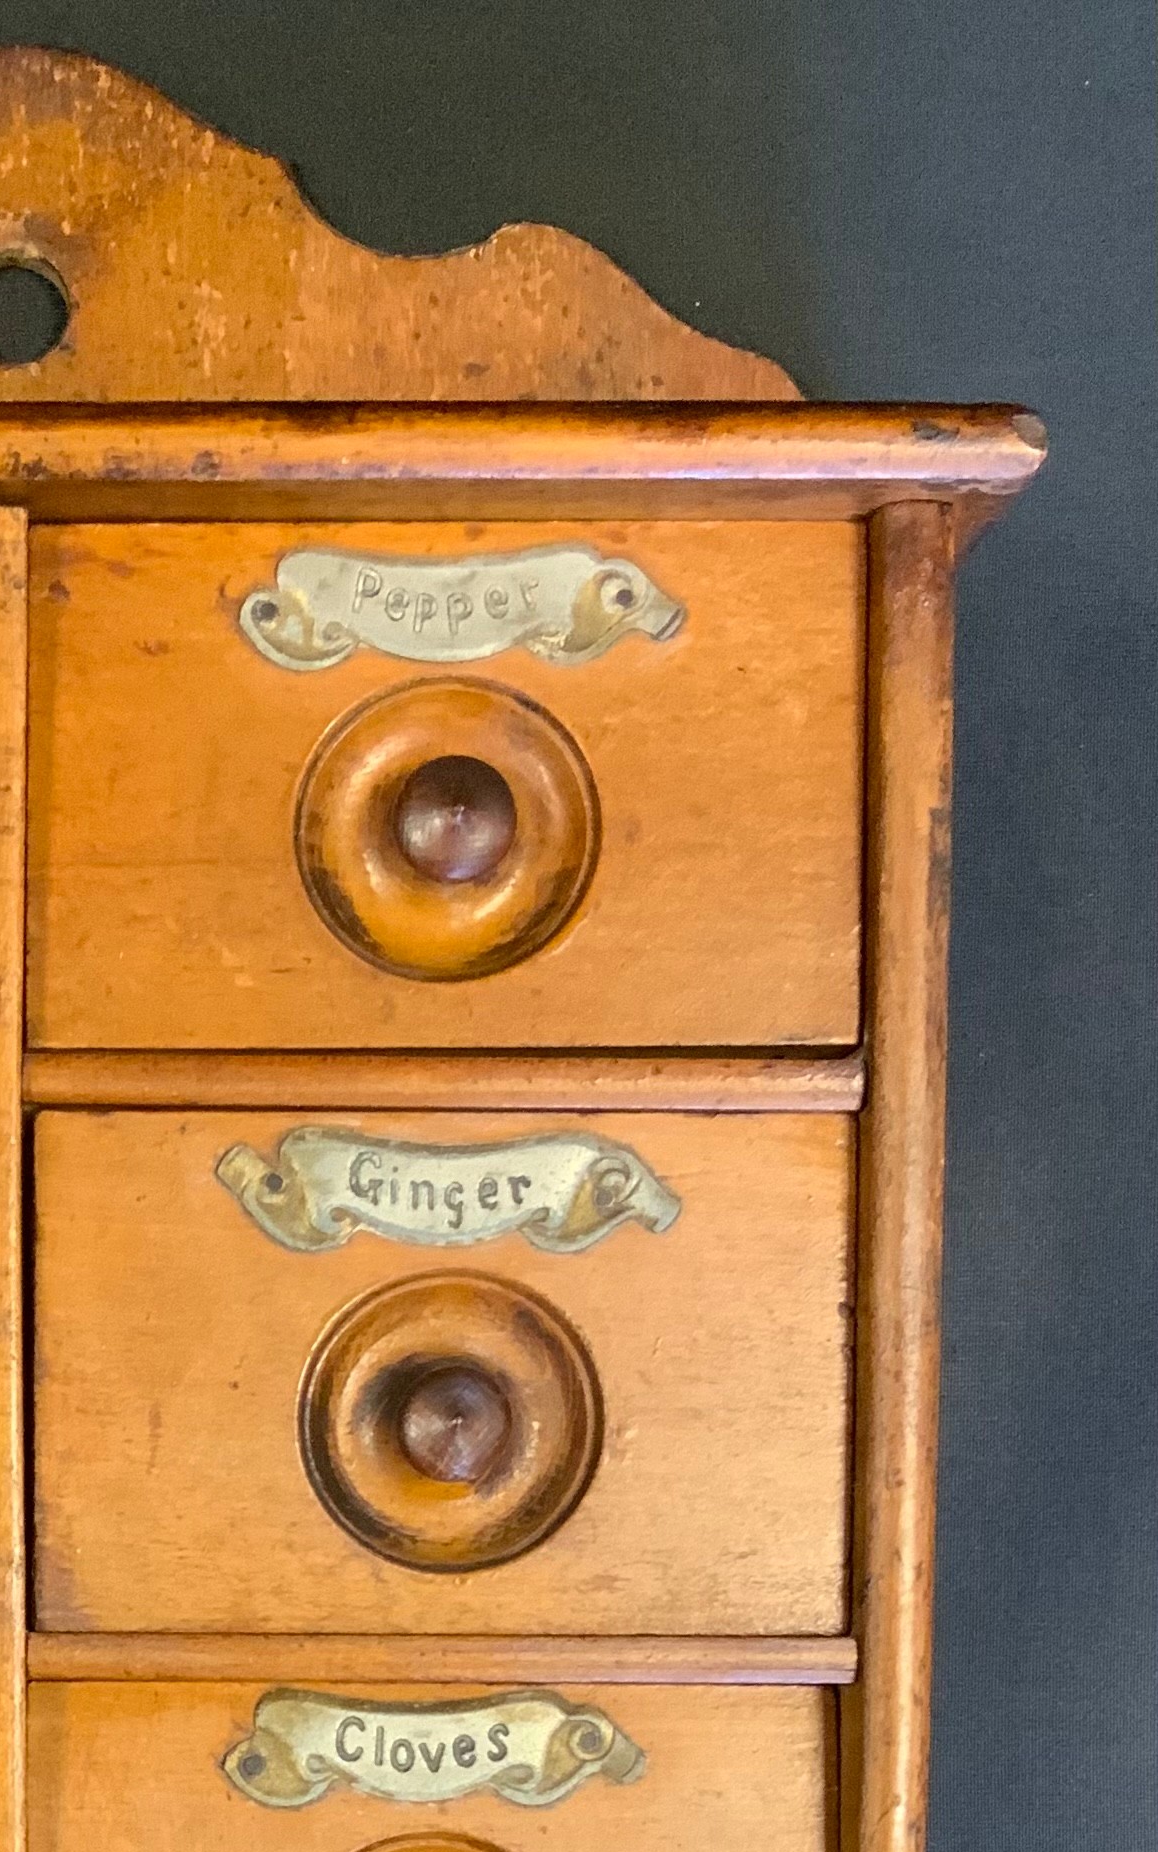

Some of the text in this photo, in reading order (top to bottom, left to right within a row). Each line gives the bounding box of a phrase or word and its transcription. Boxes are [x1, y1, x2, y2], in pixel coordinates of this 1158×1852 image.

[351, 566, 540, 635] Pepper
[349, 1150, 532, 1229] Ginger
[335, 1715, 510, 1774] Cloves
